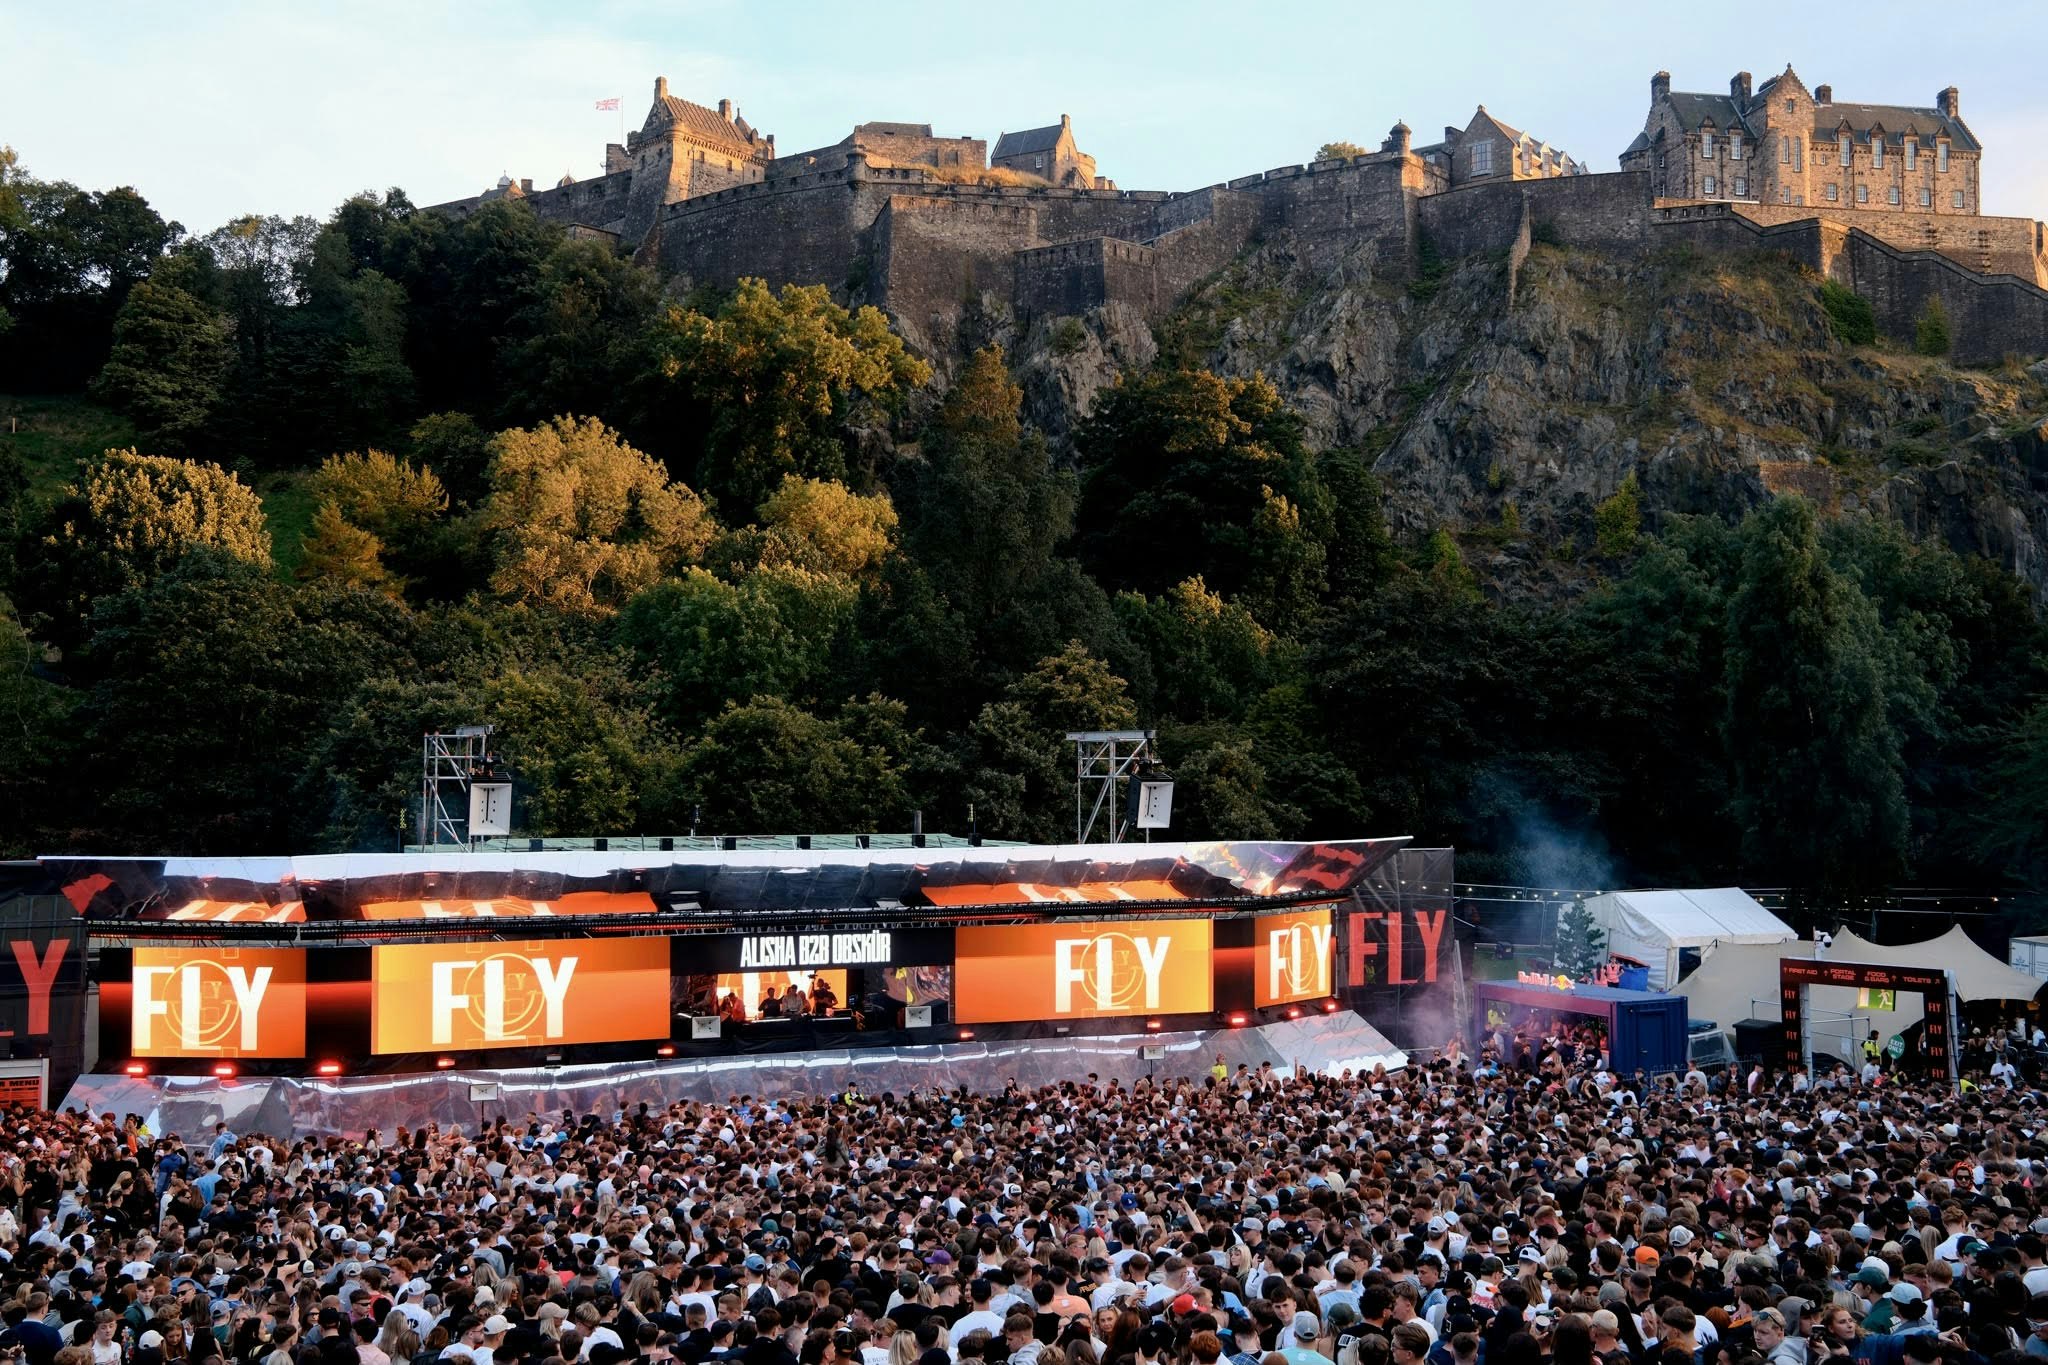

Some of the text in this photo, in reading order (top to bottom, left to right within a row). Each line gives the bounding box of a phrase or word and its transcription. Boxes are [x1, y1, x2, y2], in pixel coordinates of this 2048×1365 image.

[740, 930, 891, 967] ALISHA B2B OBSKÜR
[1348, 909, 1446, 986] FLY
[1270, 923, 1332, 1000] FLY
[1055, 936, 1171, 1013] FLY
[1830, 968, 1856, 976] PORTAL
[1903, 976, 1931, 984] TOILETS
[0, 939, 70, 1036] Y
[1784, 990, 1795, 999] FLY
[432, 957, 578, 1044] FLY
[133, 966, 273, 1050] FLY
[1928, 1002, 1941, 1012] FLY
[1785, 1010, 1796, 1019] FLY
[1930, 1024, 1942, 1034] FLY
[1786, 1030, 1797, 1040] FLY
[1890, 1039, 1903, 1047] EXIT
[1888, 1044, 1903, 1053] ONLY
[1930, 1047, 1943, 1056] FLY
[1787, 1051, 1798, 1060] FLY
[1932, 1068, 1945, 1078] FLY
